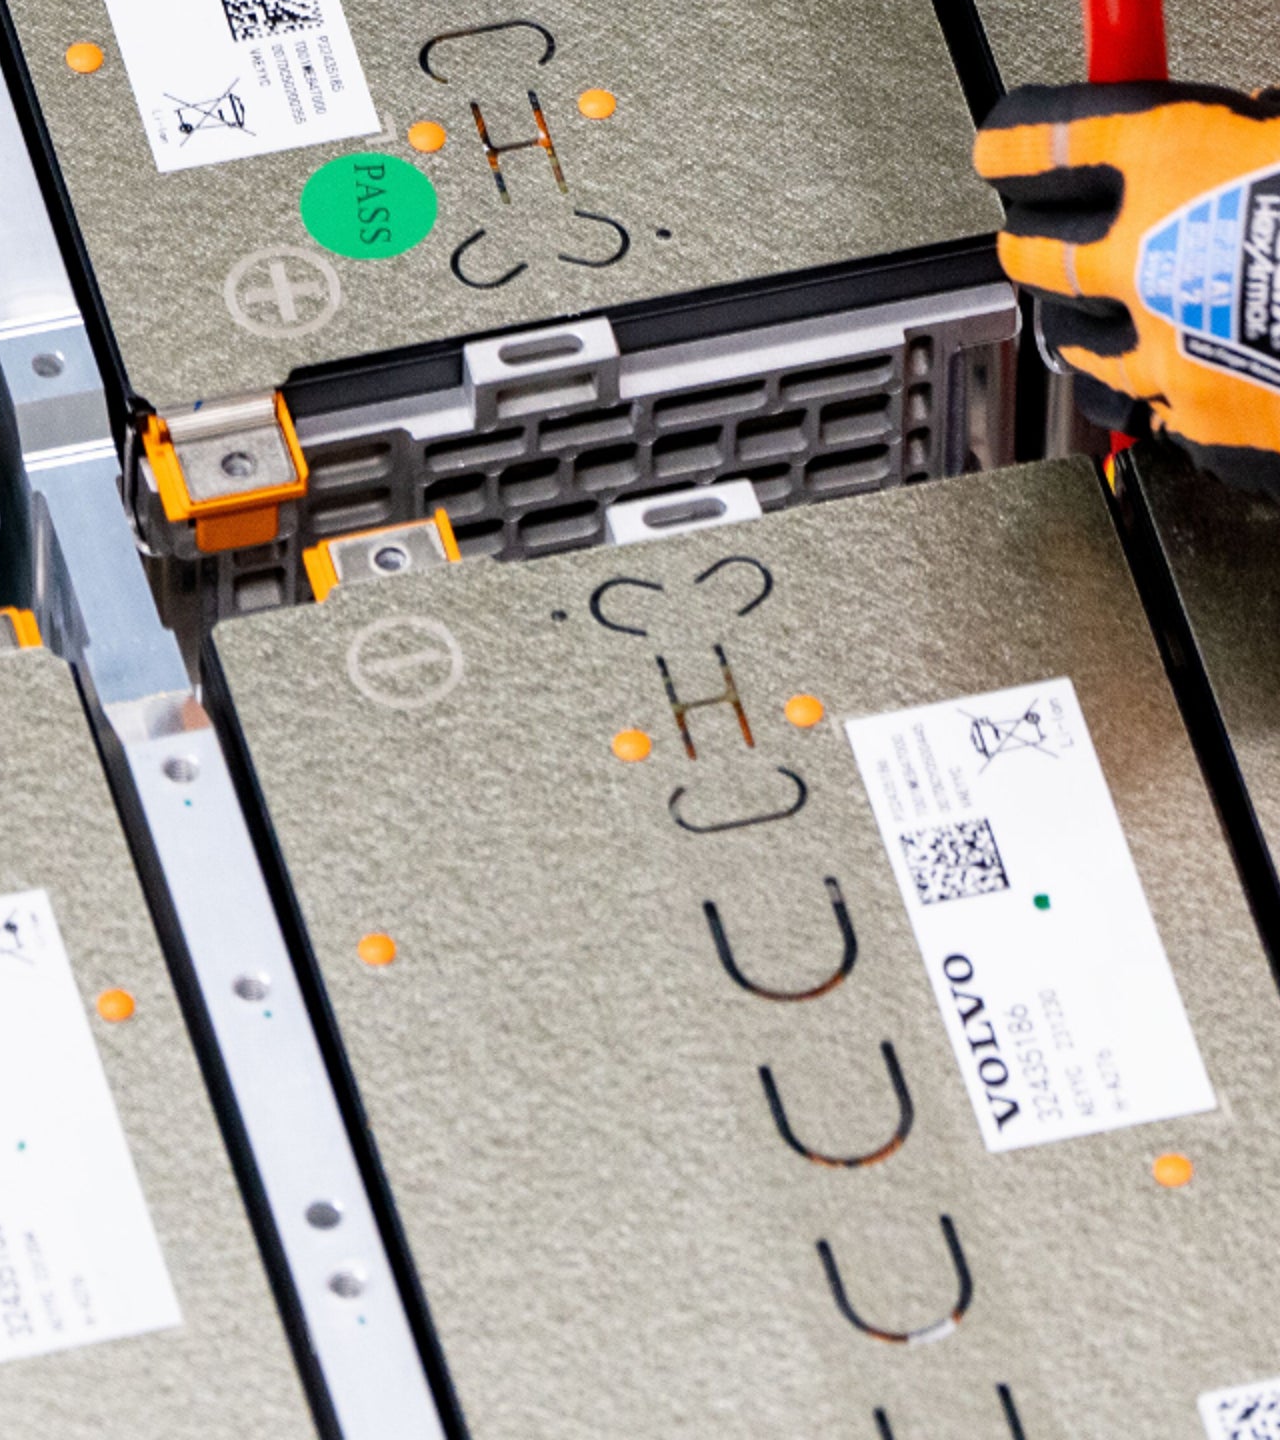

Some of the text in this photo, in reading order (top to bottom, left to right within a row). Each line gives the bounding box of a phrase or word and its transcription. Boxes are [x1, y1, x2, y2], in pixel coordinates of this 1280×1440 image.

[352, 162, 392, 246] PASS
[943, 953, 1020, 1130] VOLVO
[1003, 1004, 1062, 1121] 32435186
